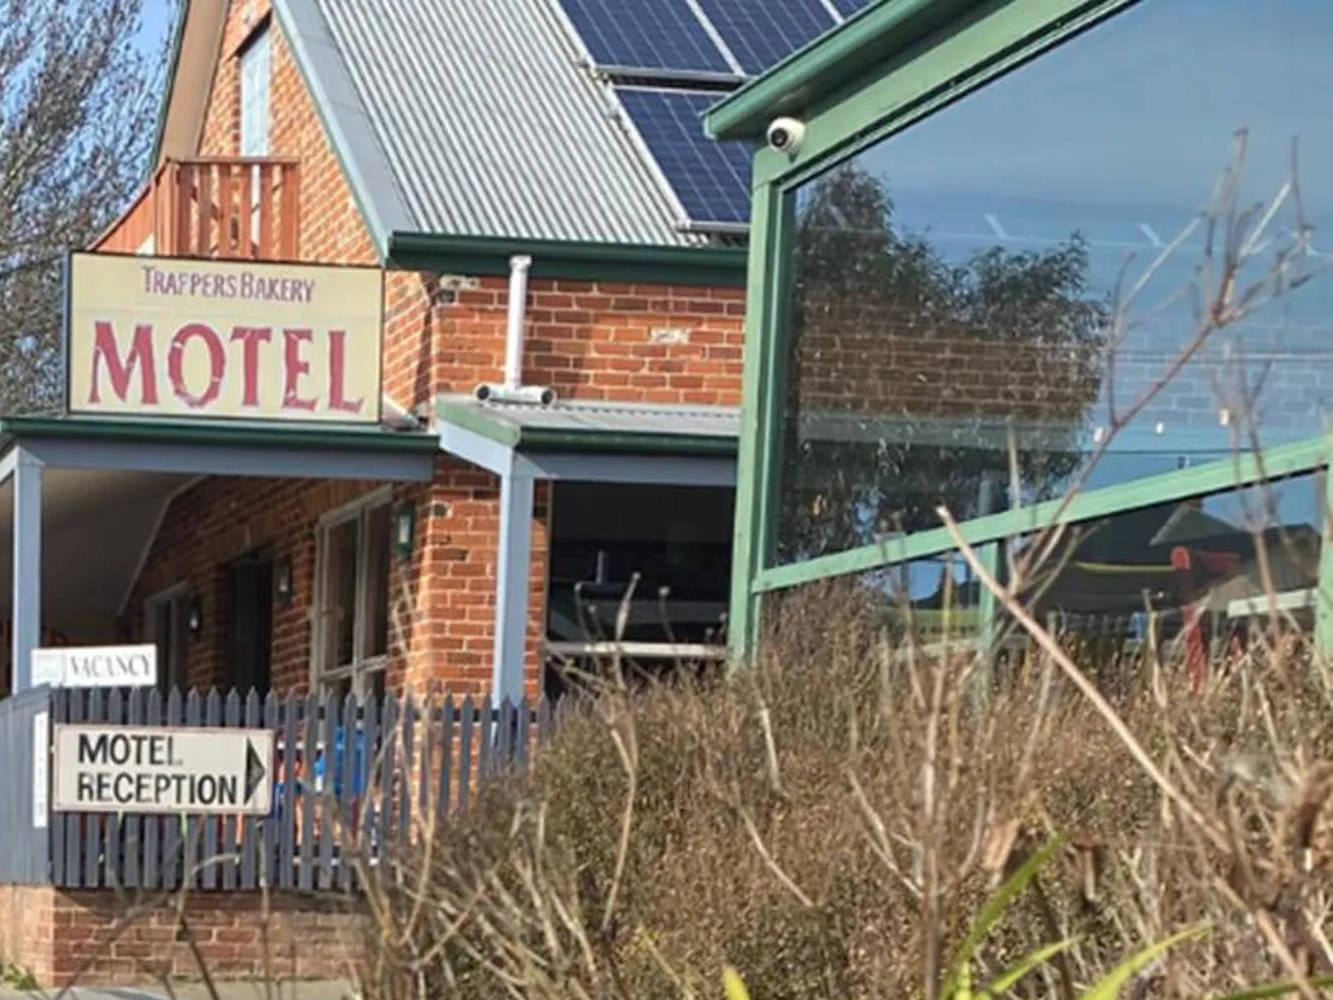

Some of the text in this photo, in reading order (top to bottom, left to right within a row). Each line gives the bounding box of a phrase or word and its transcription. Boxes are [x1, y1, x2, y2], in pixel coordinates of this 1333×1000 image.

[87, 320, 365, 413] MOTEL
[77, 733, 184, 767] MOTEL
[77, 772, 238, 806] RECEPTION
